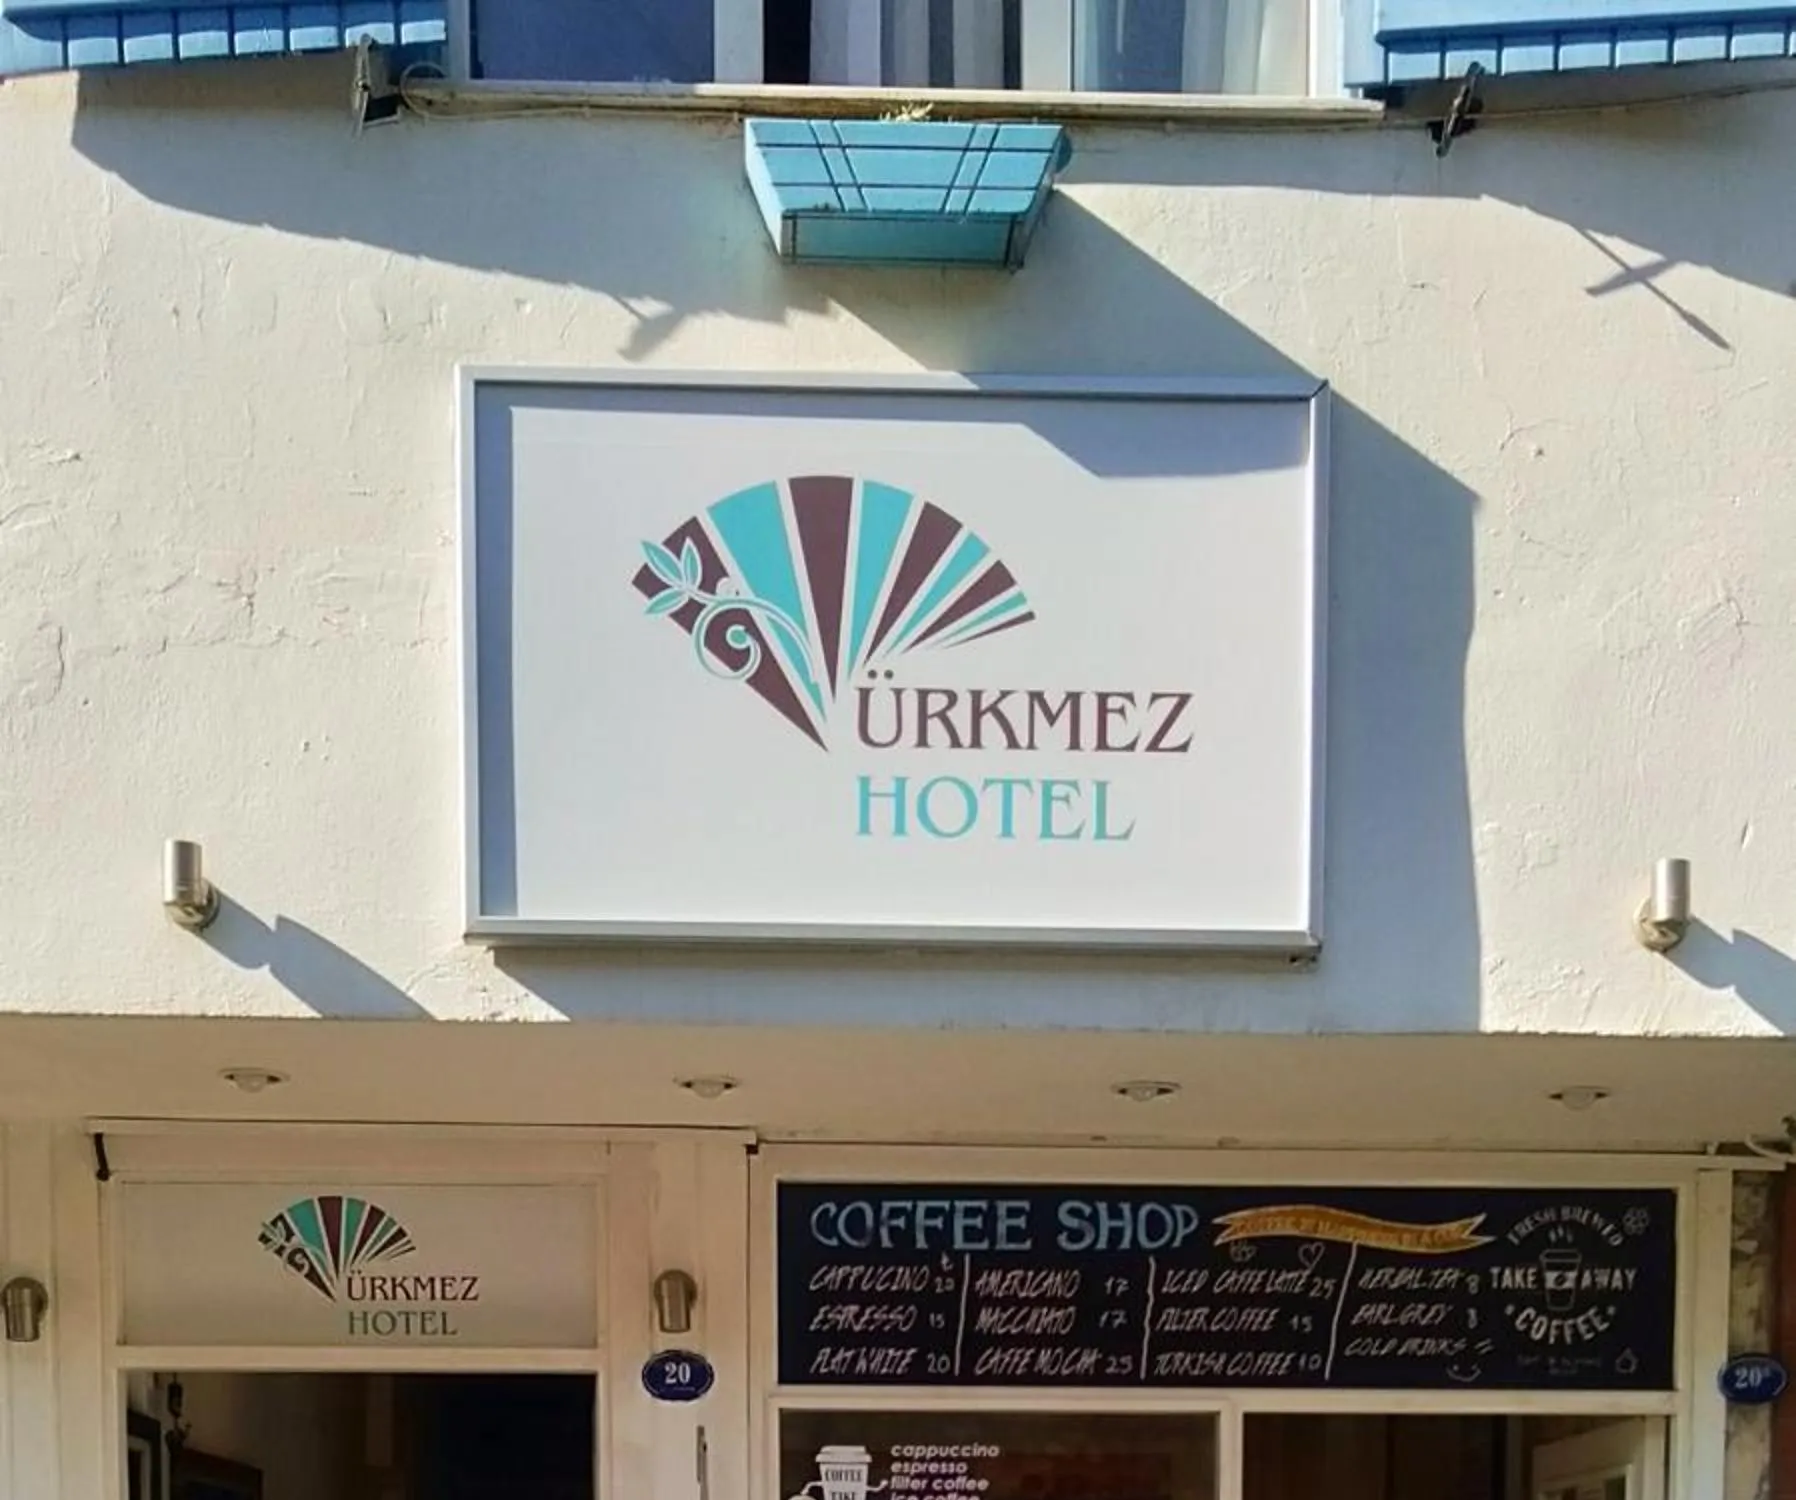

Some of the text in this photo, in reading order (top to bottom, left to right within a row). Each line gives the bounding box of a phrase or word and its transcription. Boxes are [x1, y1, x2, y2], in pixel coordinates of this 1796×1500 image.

[856, 669, 1195, 753] ÜRKMEZ
[856, 775, 1136, 840] HOTEL
[810, 1200, 1199, 1250] COFFEE SHOP
[1506, 1206, 1556, 1246] FRESH
[346, 1270, 479, 1301] ÜRKMEZ
[809, 1263, 930, 1293] CAPPUCINO
[974, 1269, 1081, 1298] AMERICANO
[1161, 1269, 1210, 1295] ICED
[1489, 1266, 1637, 1291] TAKE AWAY
[348, 1310, 457, 1336] HOTEL
[808, 1303, 918, 1332] ESPRESSO
[1210, 1306, 1281, 1332] COFFEE
[1513, 1304, 1611, 1346] COFFEE
[664, 1361, 691, 1385] 20
[809, 1347, 951, 1376] FLAT WHITE 20
[890, 1442, 1000, 1459] cappuccino
[890, 1461, 969, 1476] espresso
[932, 1476, 990, 1490] coffee
